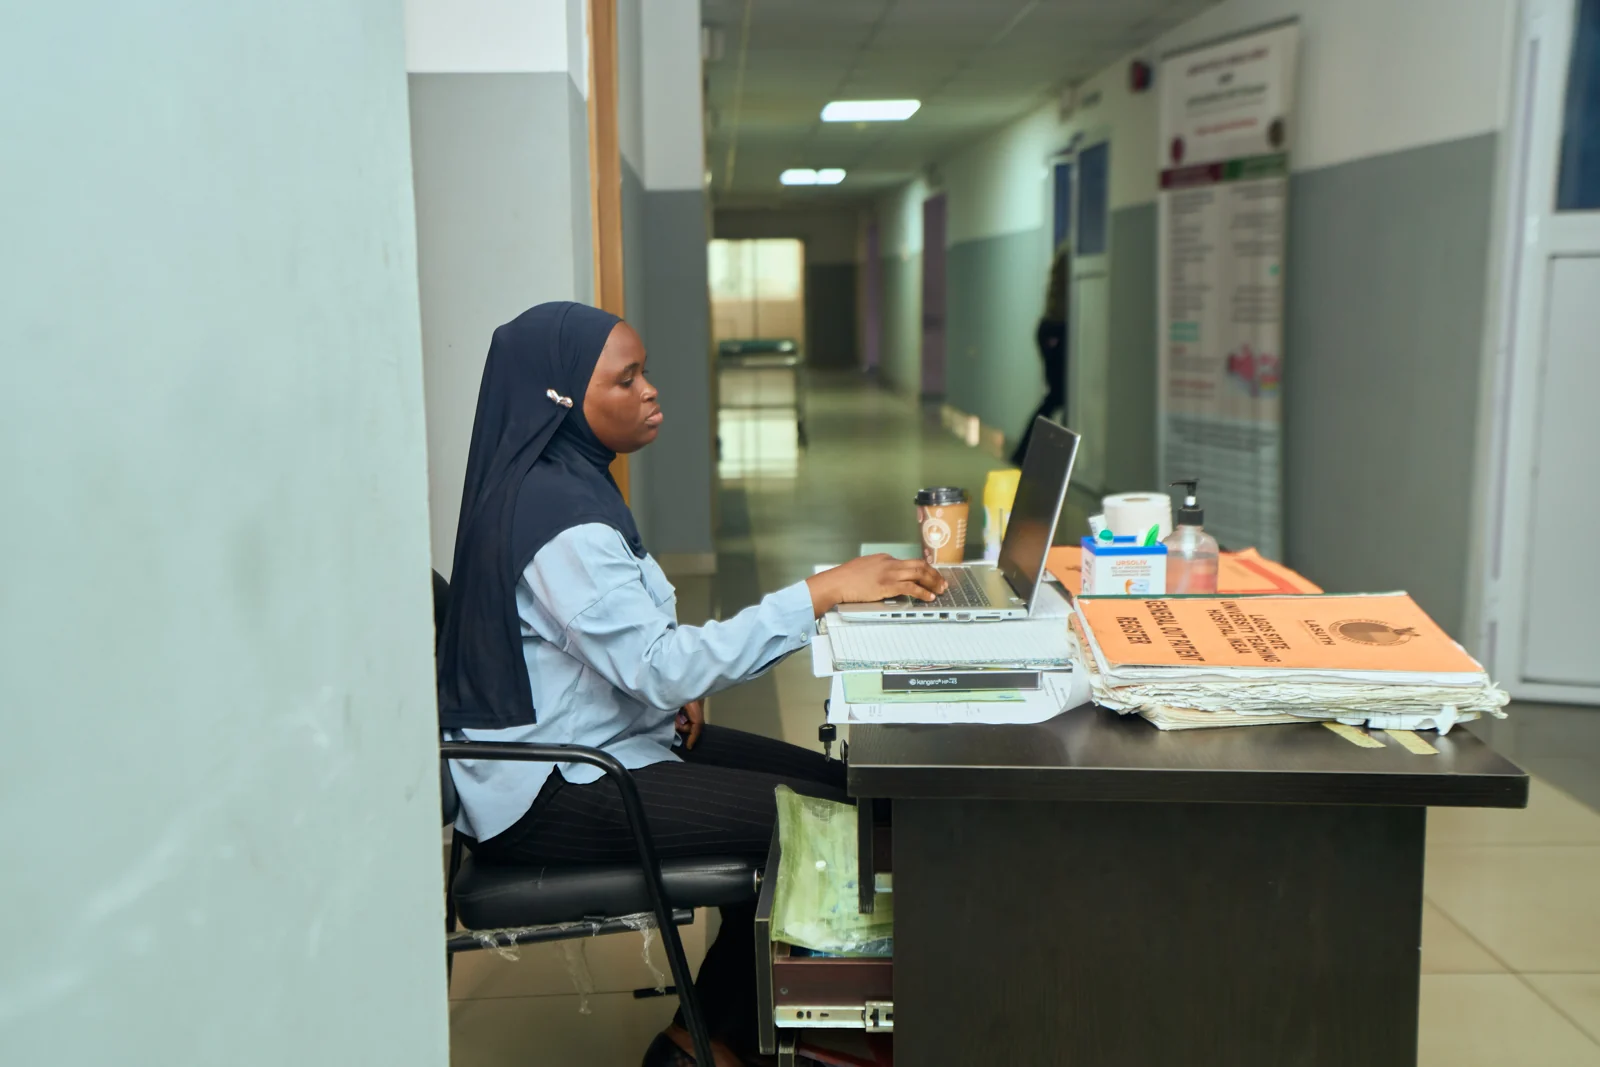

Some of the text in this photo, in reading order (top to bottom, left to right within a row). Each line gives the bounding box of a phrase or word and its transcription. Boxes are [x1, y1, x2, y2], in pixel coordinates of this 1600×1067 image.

[1115, 616, 1152, 644] REGISTER
[1144, 600, 1206, 661] GENERAL OUT PATIENT
[1220, 601, 1282, 663] UNIVERSITY TEACHING
[1248, 614, 1291, 650] LAGOS STATE
[1303, 619, 1336, 646] LASUTH
[1226, 638, 1253, 655] IKEJA
